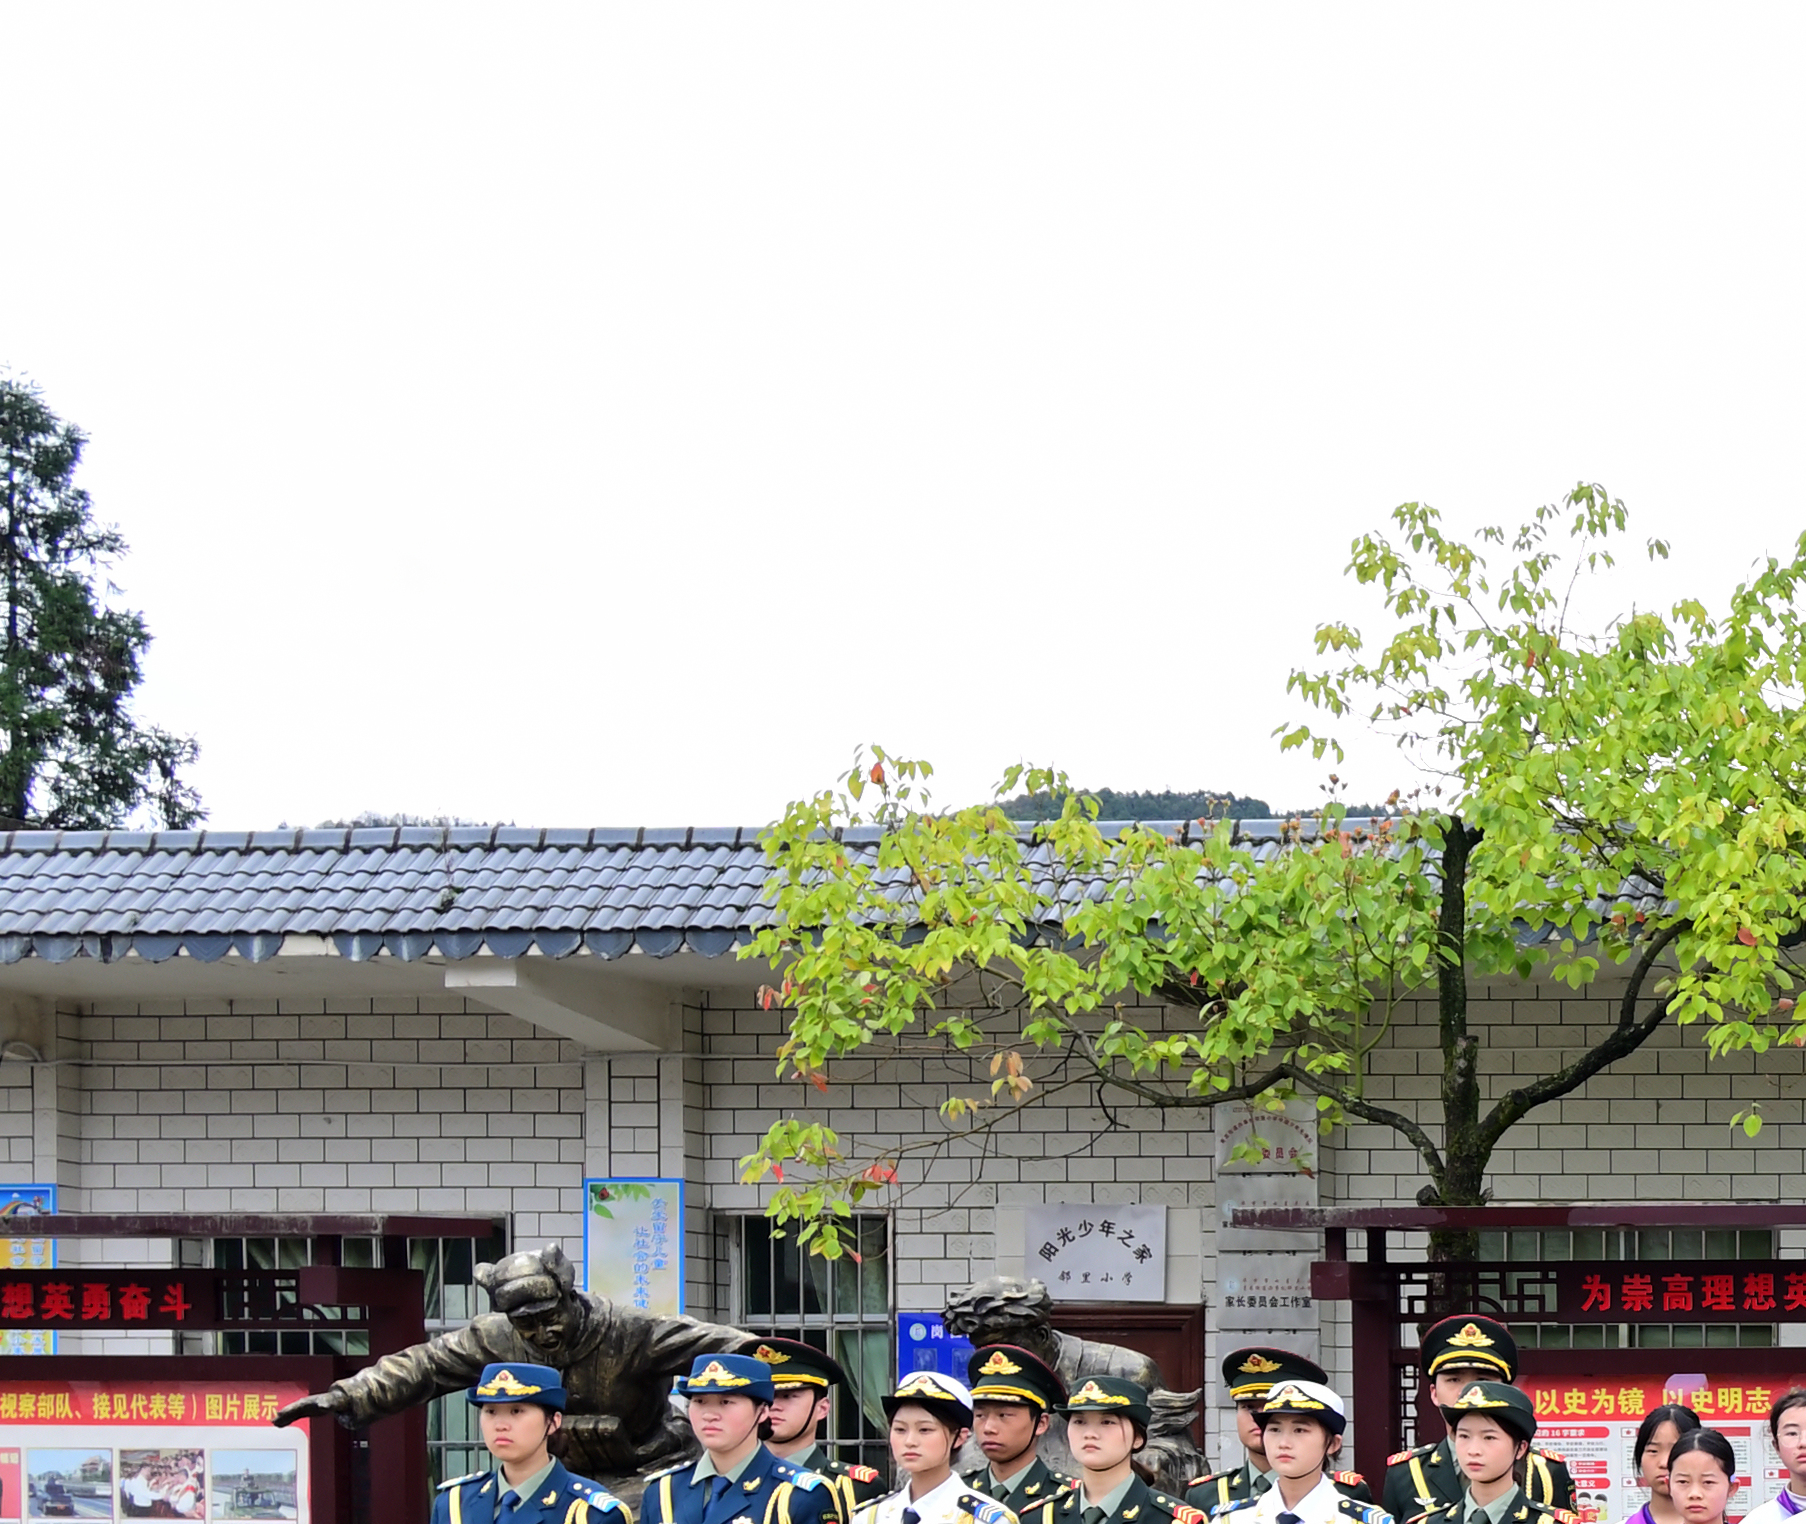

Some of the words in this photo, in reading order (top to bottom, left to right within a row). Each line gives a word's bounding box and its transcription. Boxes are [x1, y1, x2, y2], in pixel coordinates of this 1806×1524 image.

[1038, 1219, 1153, 1264] 阳光少年之家
[2, 1283, 191, 1321] 想英勇奋斗
[1225, 1296, 1312, 1309] 家长委员会工作室
[1535, 1387, 1645, 1415] 以史为镜
[1662, 1386, 1773, 1414] 以史明志
